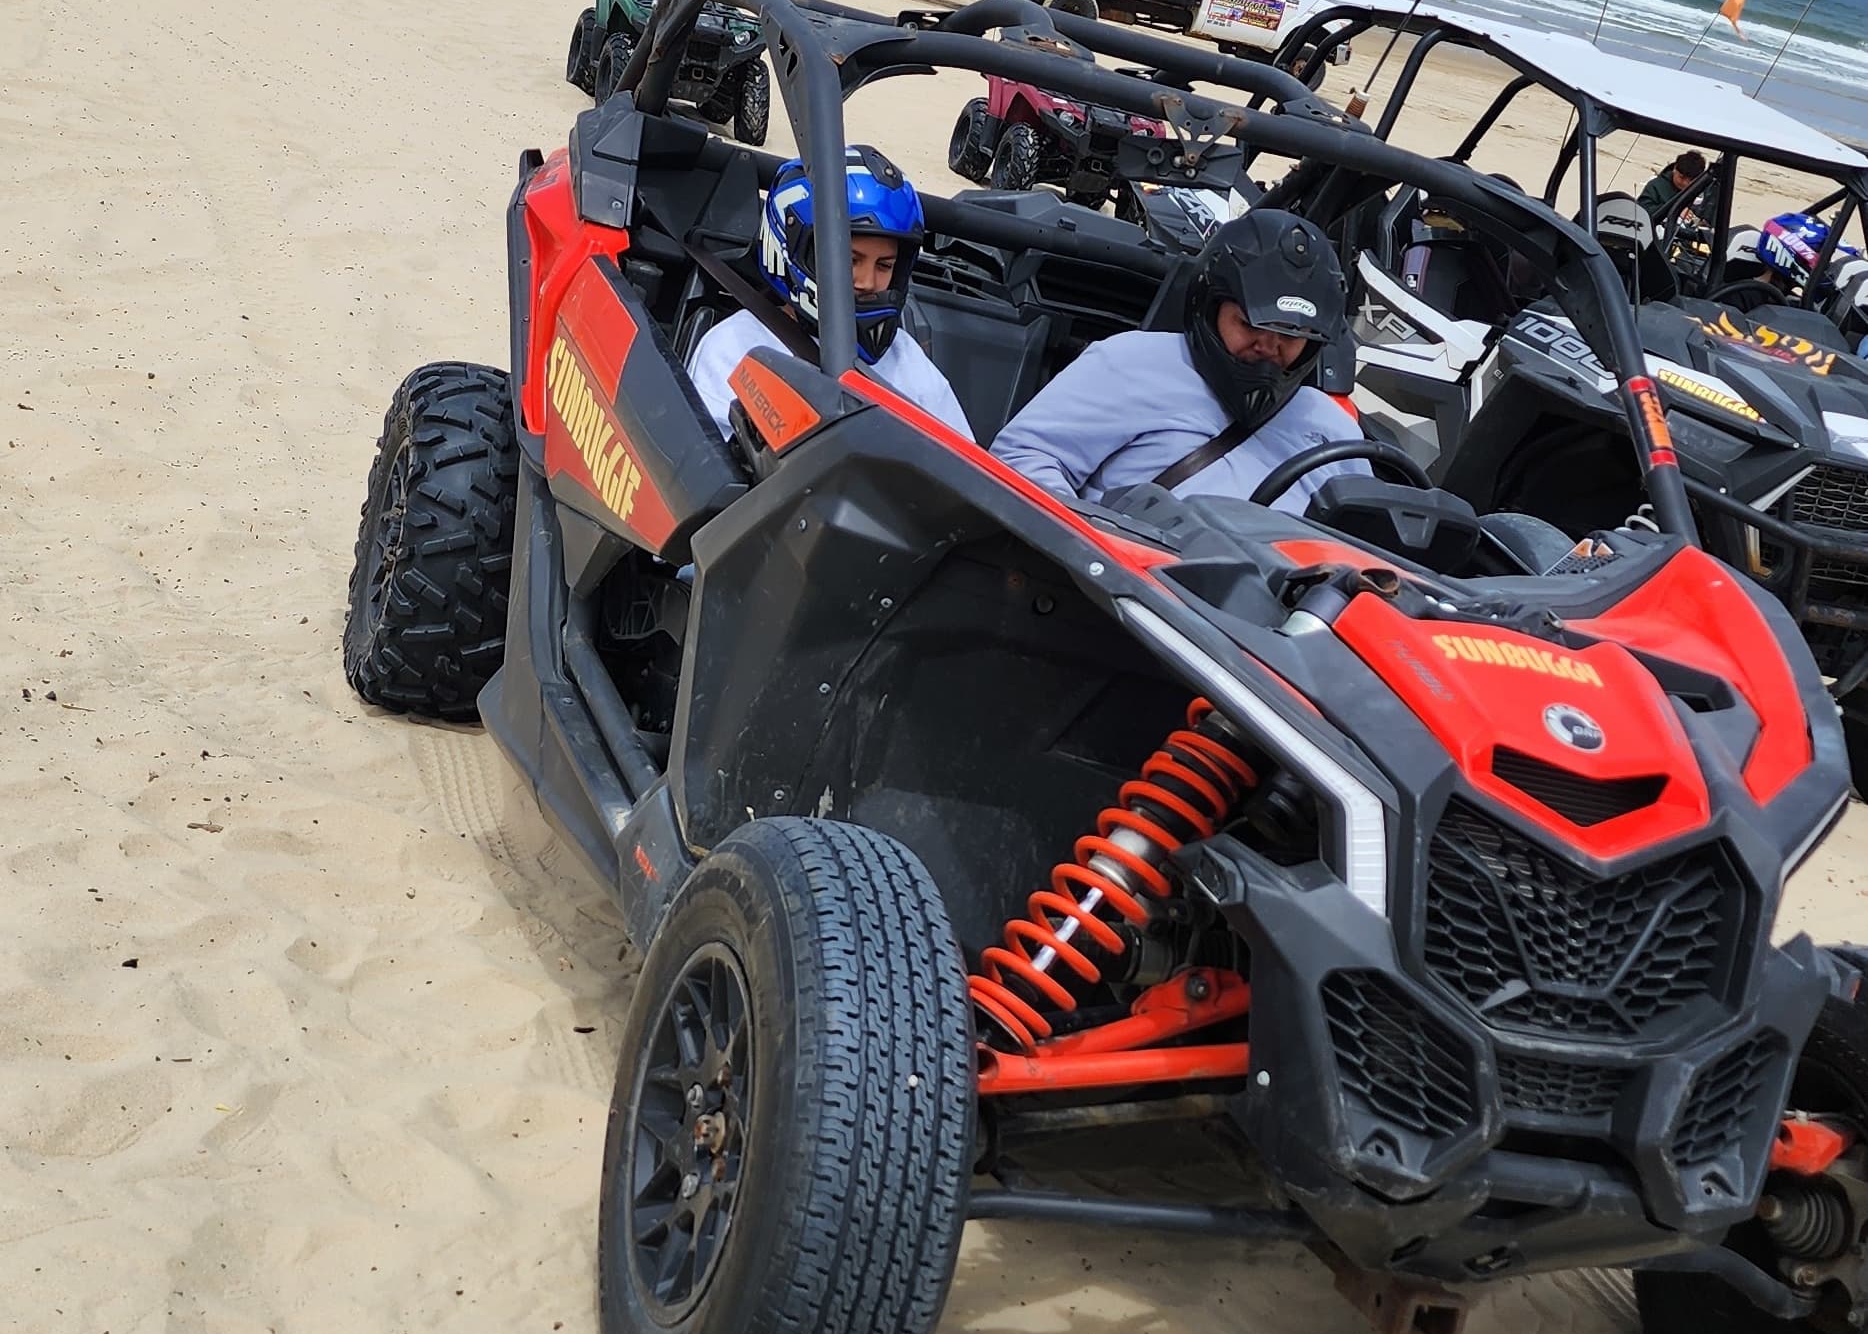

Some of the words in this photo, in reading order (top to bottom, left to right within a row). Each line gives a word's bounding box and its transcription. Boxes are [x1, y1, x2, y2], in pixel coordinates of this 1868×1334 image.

[1599, 214, 1644, 231] RZR
[1358, 292, 1417, 340] XP
[738, 365, 787, 437] MAVERICK
[1658, 369, 1760, 422] SUNBUGGY
[548, 336, 642, 522] SUNBUGGIE
[1431, 633, 1604, 688] SUNBUGGY
